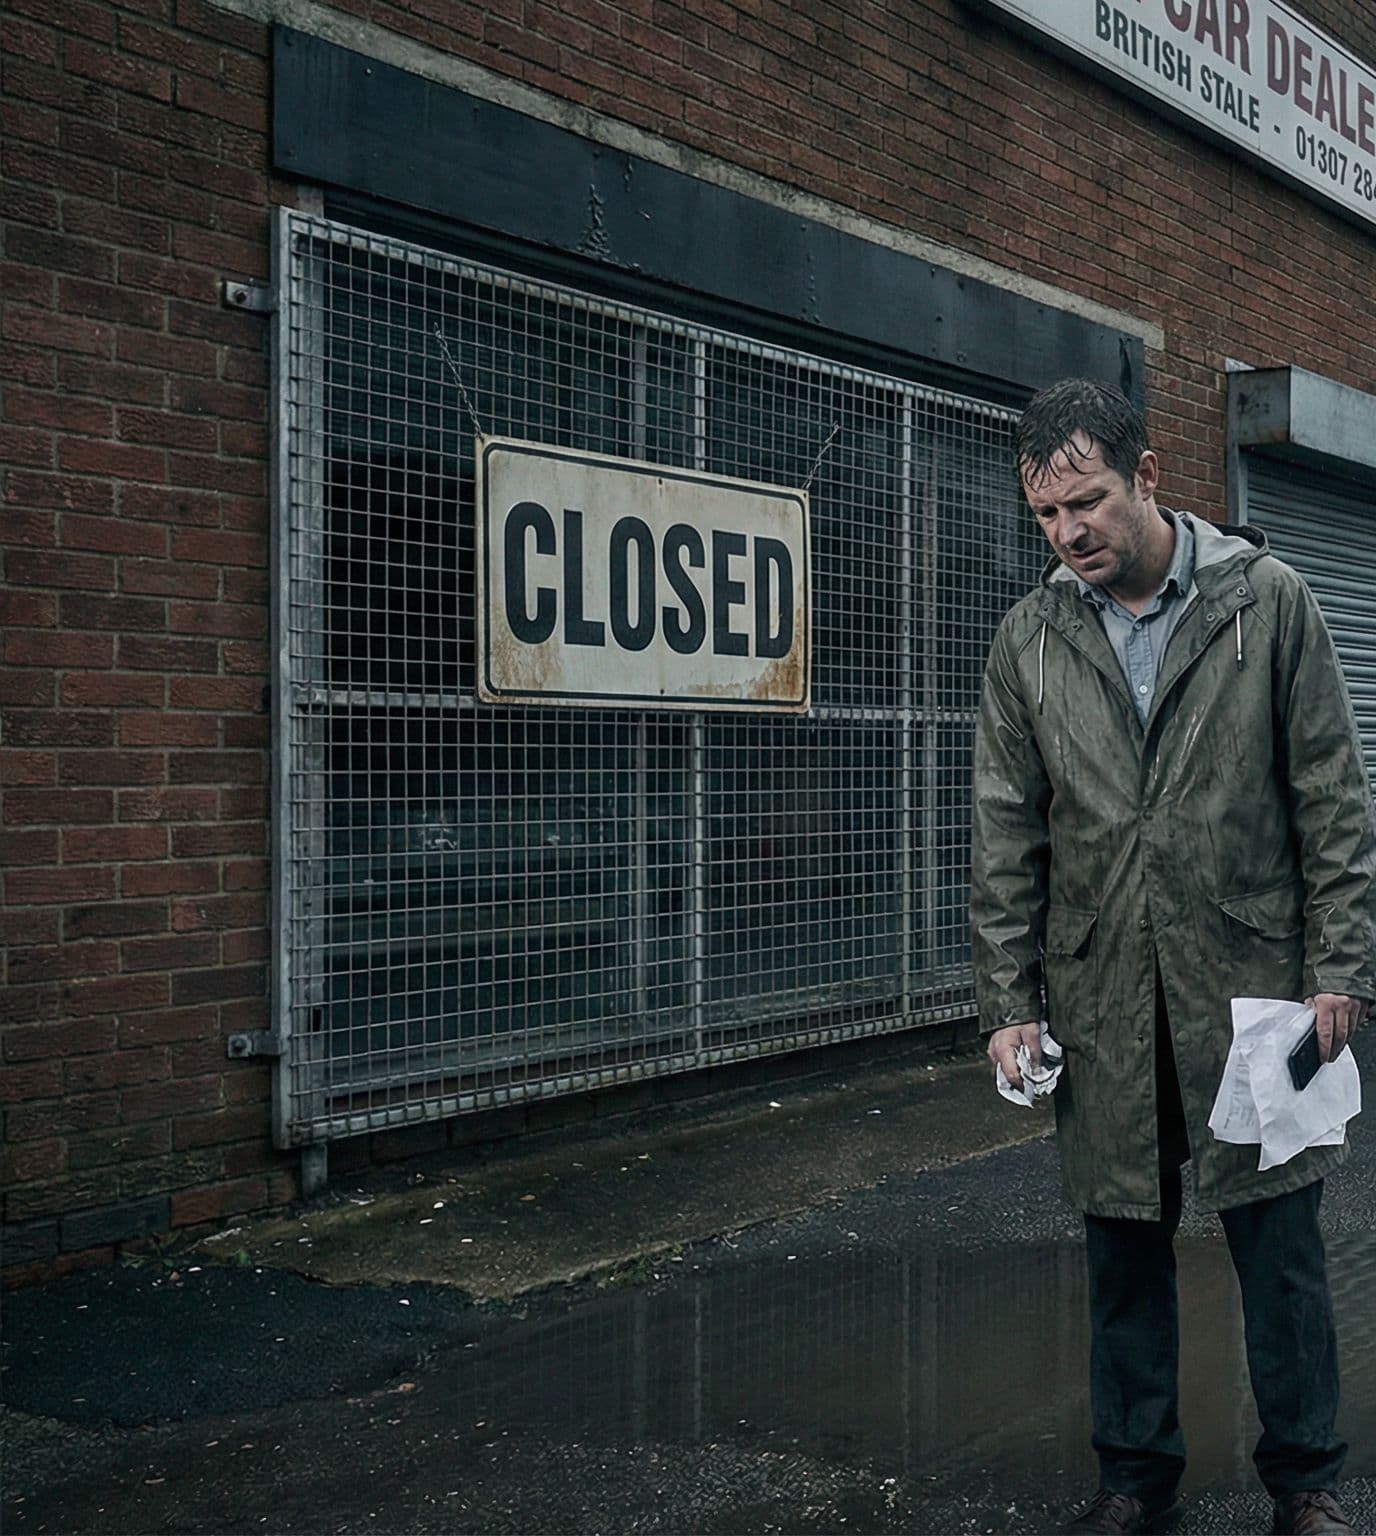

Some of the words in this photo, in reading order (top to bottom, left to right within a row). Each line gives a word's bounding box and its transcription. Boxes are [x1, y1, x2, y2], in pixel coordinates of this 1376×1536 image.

[1096, 0, 1191, 92] BRITISH
[1200, 64, 1259, 133] STALE
[1296, 126, 1347, 185] 01307
[505, 502, 793, 658] CLOSED
